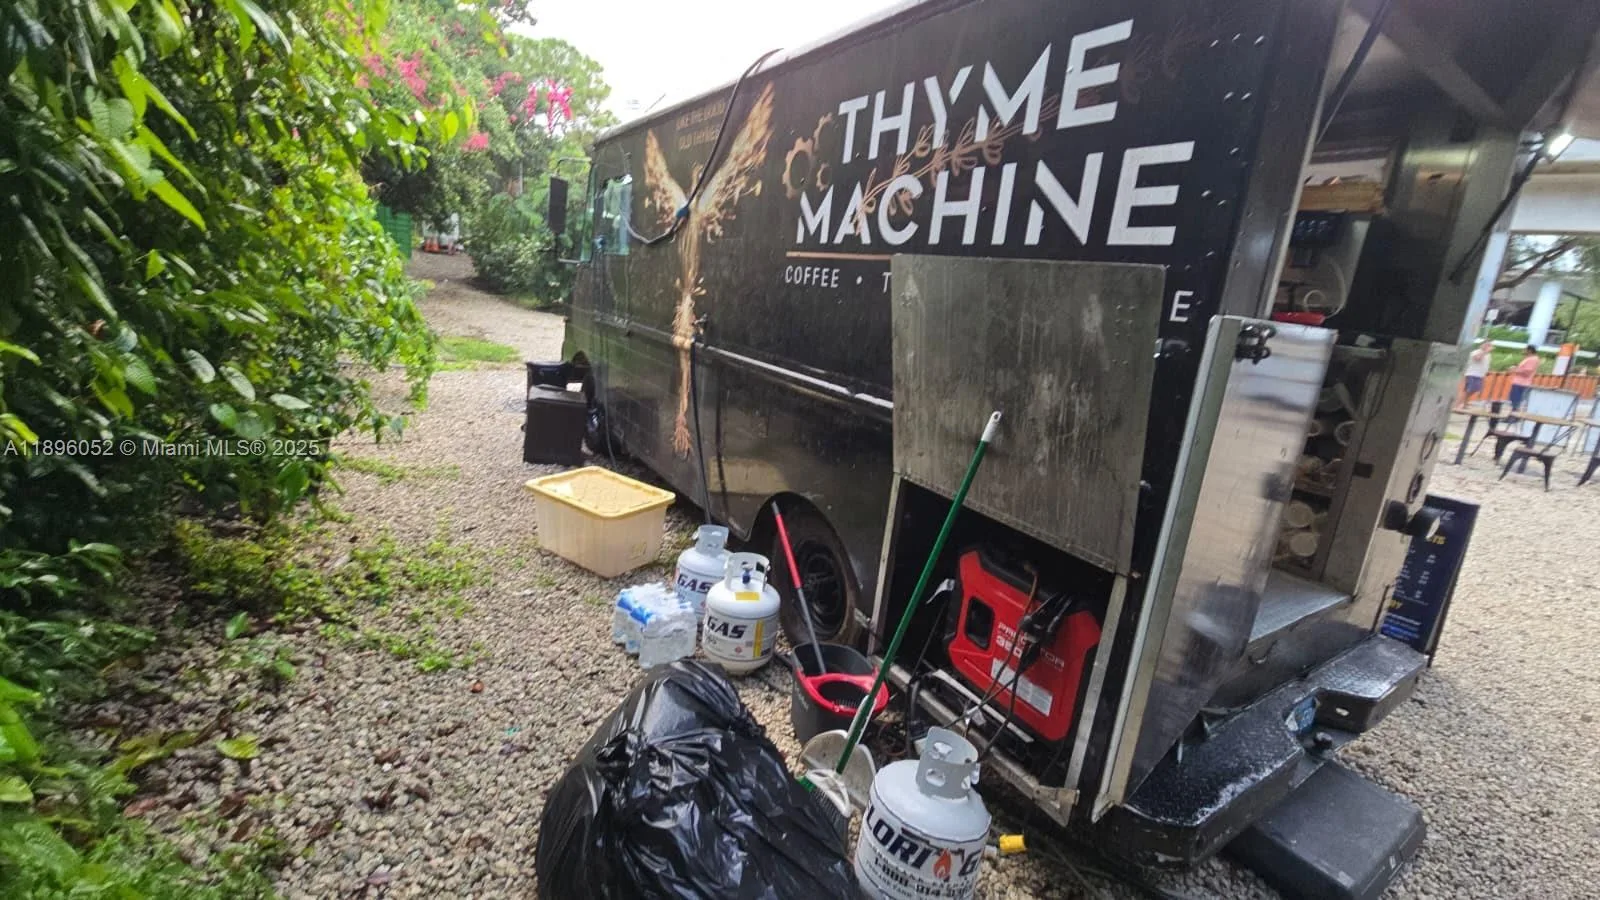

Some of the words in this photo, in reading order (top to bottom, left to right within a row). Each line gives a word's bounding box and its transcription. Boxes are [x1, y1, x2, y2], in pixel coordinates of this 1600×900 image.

[838, 18, 1134, 164] THYME
[796, 140, 1195, 247] MACHINE
[784, 265, 840, 289] COFFEE
[677, 573, 713, 593] GAS
[707, 615, 748, 639] GAS
